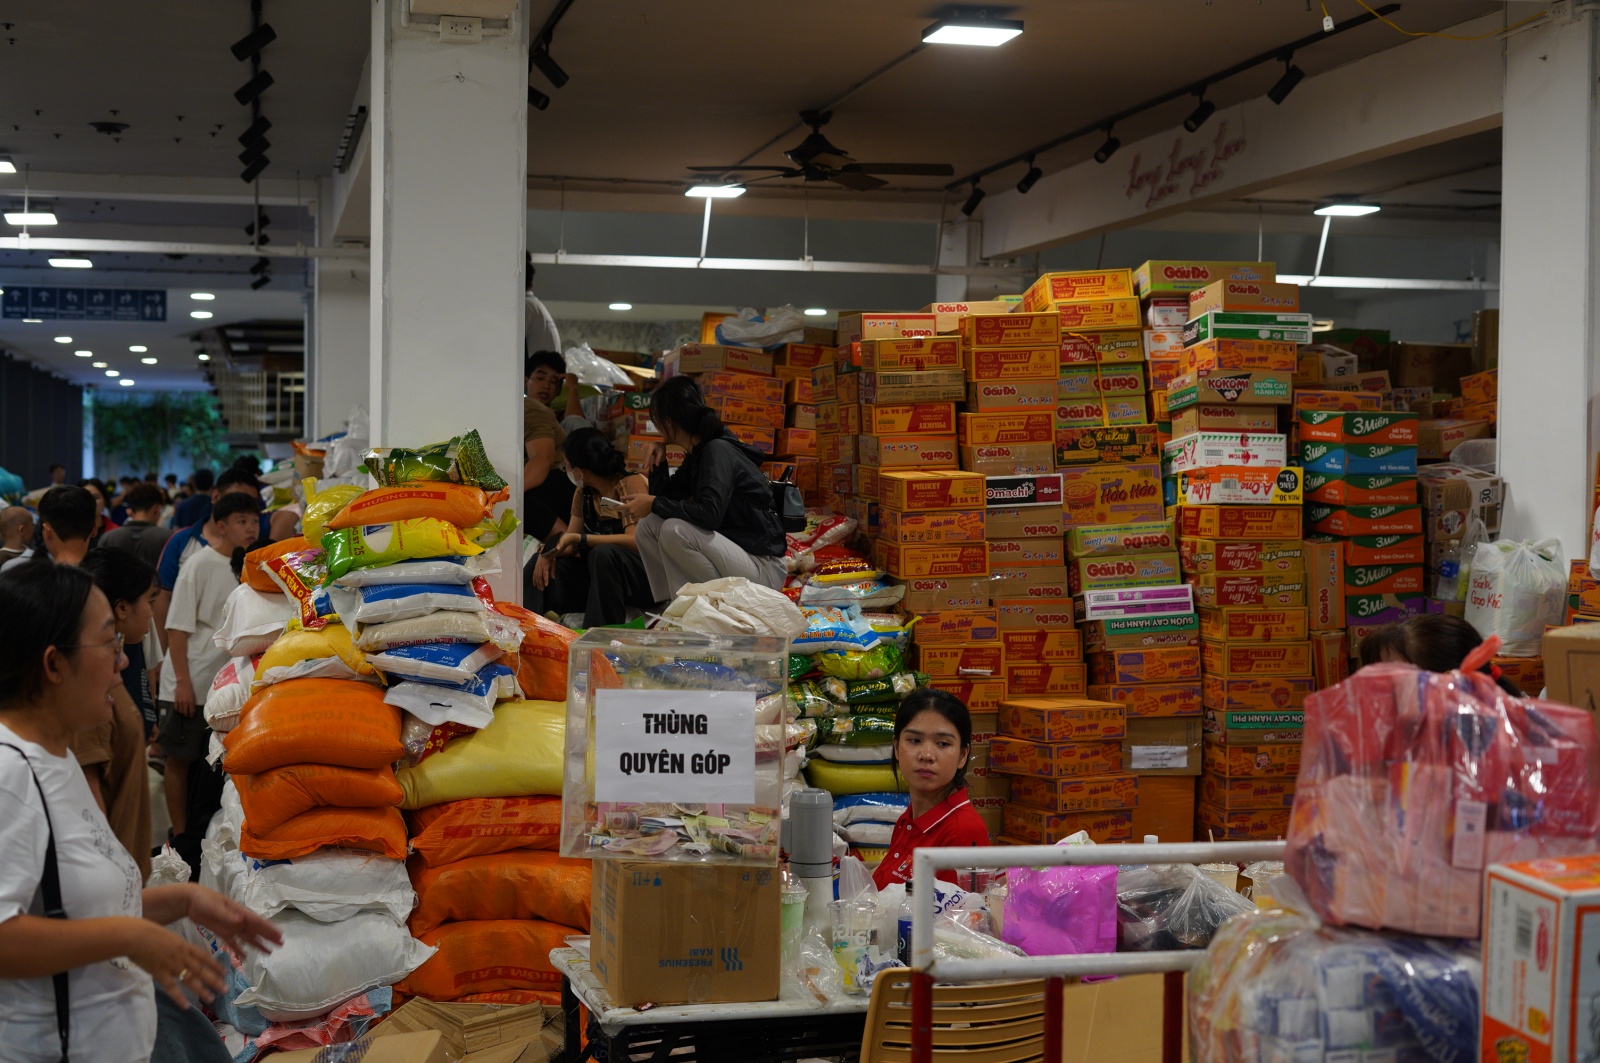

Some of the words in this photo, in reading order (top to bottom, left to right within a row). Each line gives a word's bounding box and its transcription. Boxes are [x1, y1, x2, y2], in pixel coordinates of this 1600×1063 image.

[1069, 278, 1102, 286] MILIKET
[999, 318, 1030, 327] MILIKET
[999, 352, 1030, 361] MILIKET
[1207, 379, 1250, 390] KOKOMI
[1274, 382, 1287, 390] CAY
[1225, 389, 1238, 399] 90
[919, 422, 946, 430] MILIKET
[1000, 431, 1029, 440] MILIKET
[1403, 433, 1413, 441] Cay
[1286, 474, 1296, 482] 03
[912, 483, 940, 491] MILIKET
[1241, 482, 1274, 495] A-One
[986, 486, 1029, 499] Omachi
[1101, 485, 1129, 504] Hảo
[1130, 480, 1158, 497] Hảo
[1482, 488, 1492, 503] 30
[1243, 511, 1272, 519] MILIKET
[934, 564, 963, 573] MILIKET
[1470, 590, 1485, 609] Gạo
[1151, 618, 1168, 627] CAY
[1247, 614, 1281, 622] MILIKET
[941, 621, 955, 631] Hảo
[957, 618, 973, 628] Hảo
[1110, 621, 1125, 629] PHI
[1143, 636, 1155, 645] 90
[1157, 634, 1187, 643] KOKOMI
[1249, 650, 1281, 658] MILIKET
[643, 710, 708, 736] THÙNG
[1233, 714, 1247, 723] PHI
[1274, 714, 1290, 723] CAY
[620, 749, 684, 776] QUYÊN
[691, 750, 731, 775] GÓP
[690, 948, 713, 956] KABI
[659, 960, 713, 968] FRESENIUS
[511, 968, 556, 981] HƠM
